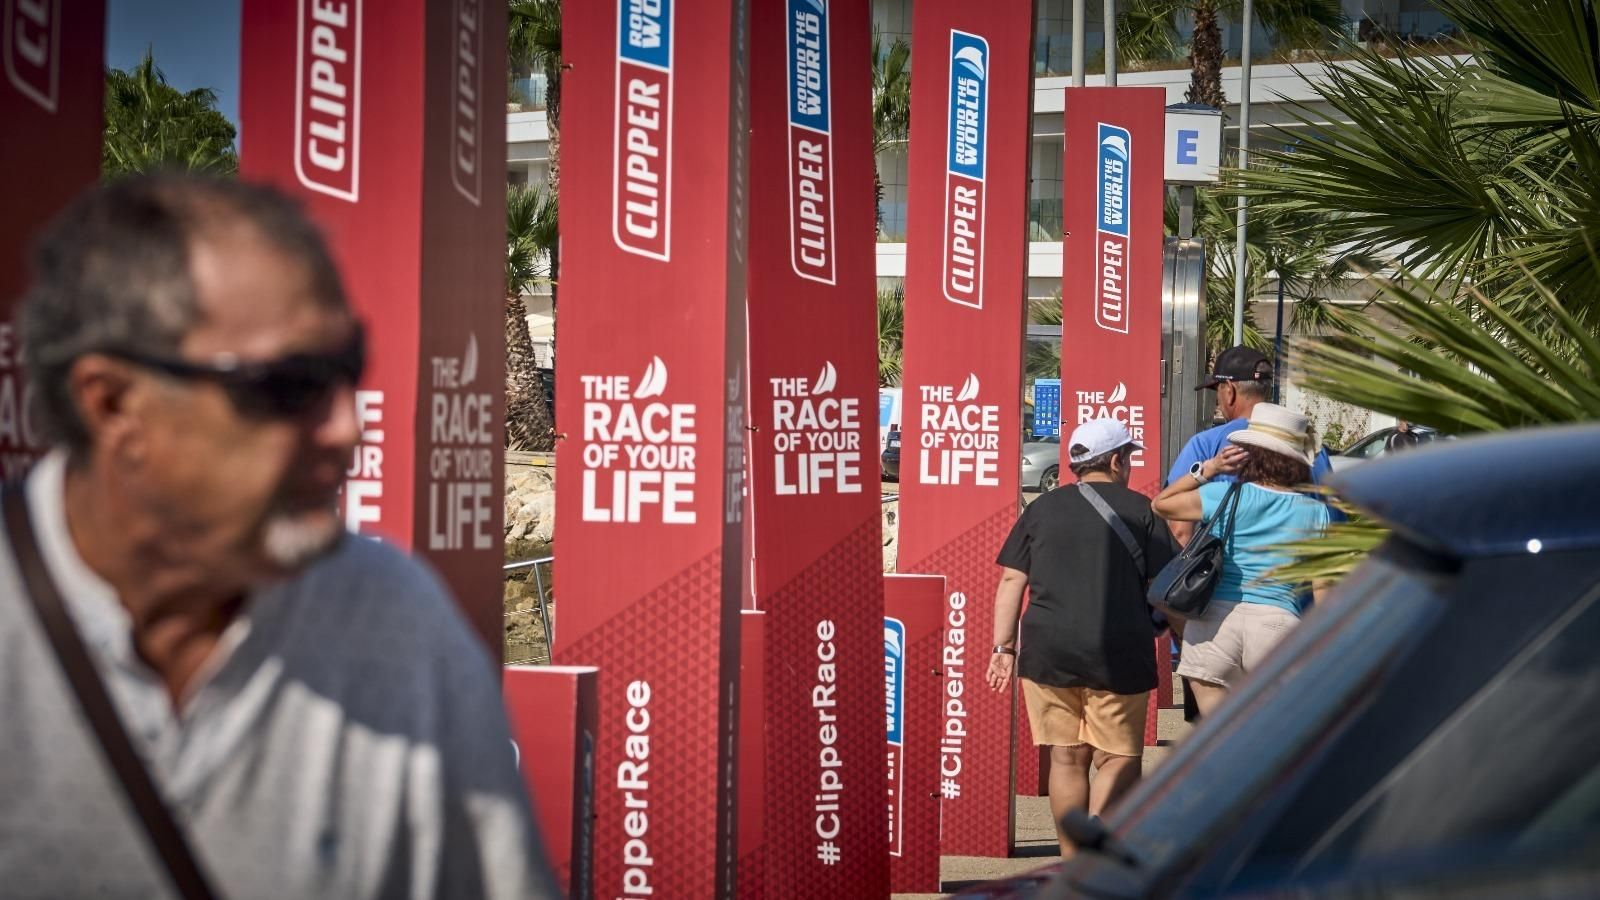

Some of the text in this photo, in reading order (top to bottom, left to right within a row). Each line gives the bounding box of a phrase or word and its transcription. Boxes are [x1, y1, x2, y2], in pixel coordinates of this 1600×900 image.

[796, 10, 808, 114] ROUND THE
[805, 12, 821, 115] WORLD
[956, 77, 967, 164] ROUND THE
[964, 79, 980, 166] WORLD
[626, 79, 660, 239] CLIPPER
[1177, 130, 1199, 164] E
[798, 140, 825, 267] CLIPPER
[1104, 157, 1113, 225] ROUND THE
[1111, 159, 1123, 226] WORLD
[952, 186, 976, 293] CLIPPER
[1102, 240, 1123, 322] CLIPPER
[432, 358, 458, 387] THE
[581, 376, 629, 400] THE
[770, 378, 808, 397] THE
[920, 386, 953, 402] THE
[432, 394, 492, 443] RACE
[774, 398, 859, 430] RACE
[922, 404, 999, 433] RACE
[1076, 392, 1104, 403] THE
[584, 403, 696, 443] RACE
[774, 432, 859, 452] OF YOUR
[921, 432, 945, 450] OF
[950, 433, 998, 449] YOUR
[431, 448, 491, 478] OF YOUR
[584, 444, 695, 469] OF YOUR
[775, 451, 861, 494] LIFE
[920, 449, 998, 485] LIFE
[430, 483, 492, 549] LIFE
[583, 470, 696, 523] LIFE
[941, 592, 967, 797] #ClipperRace
[813, 619, 844, 865] #ClipperRace
[616, 680, 653, 900] pperRace
